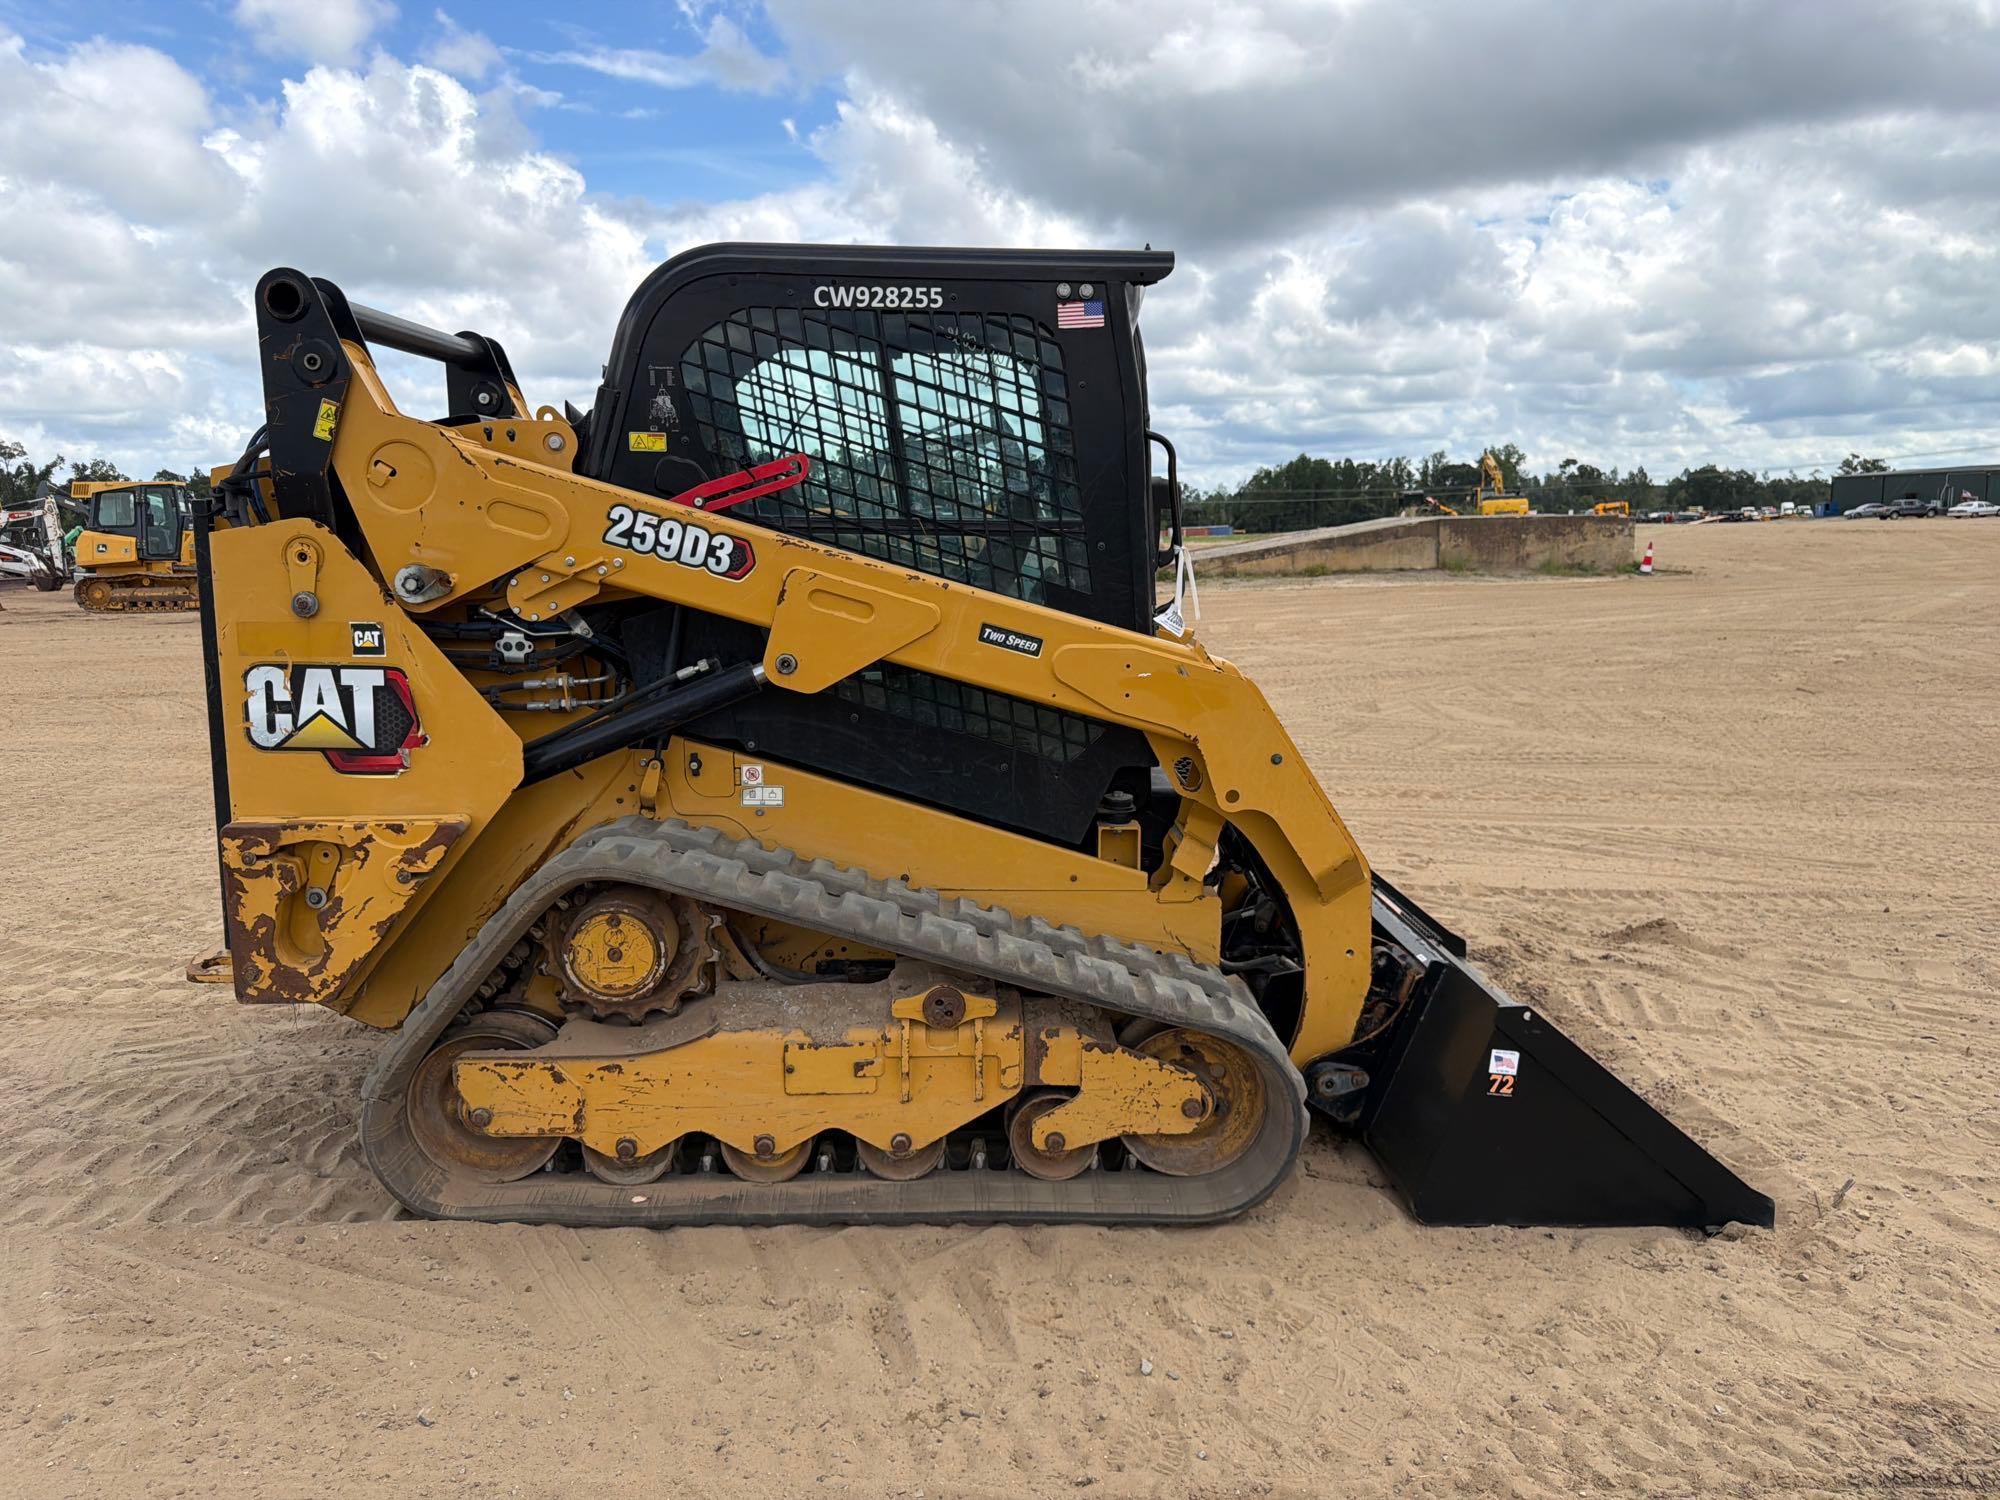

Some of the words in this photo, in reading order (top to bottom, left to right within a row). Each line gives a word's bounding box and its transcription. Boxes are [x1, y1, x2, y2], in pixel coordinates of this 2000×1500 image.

[813, 285, 945, 310] CW928255
[605, 506, 734, 575] 259D3
[353, 630, 381, 648] CAT
[246, 665, 385, 749] CAT
[1489, 1074, 1515, 1095] 72
